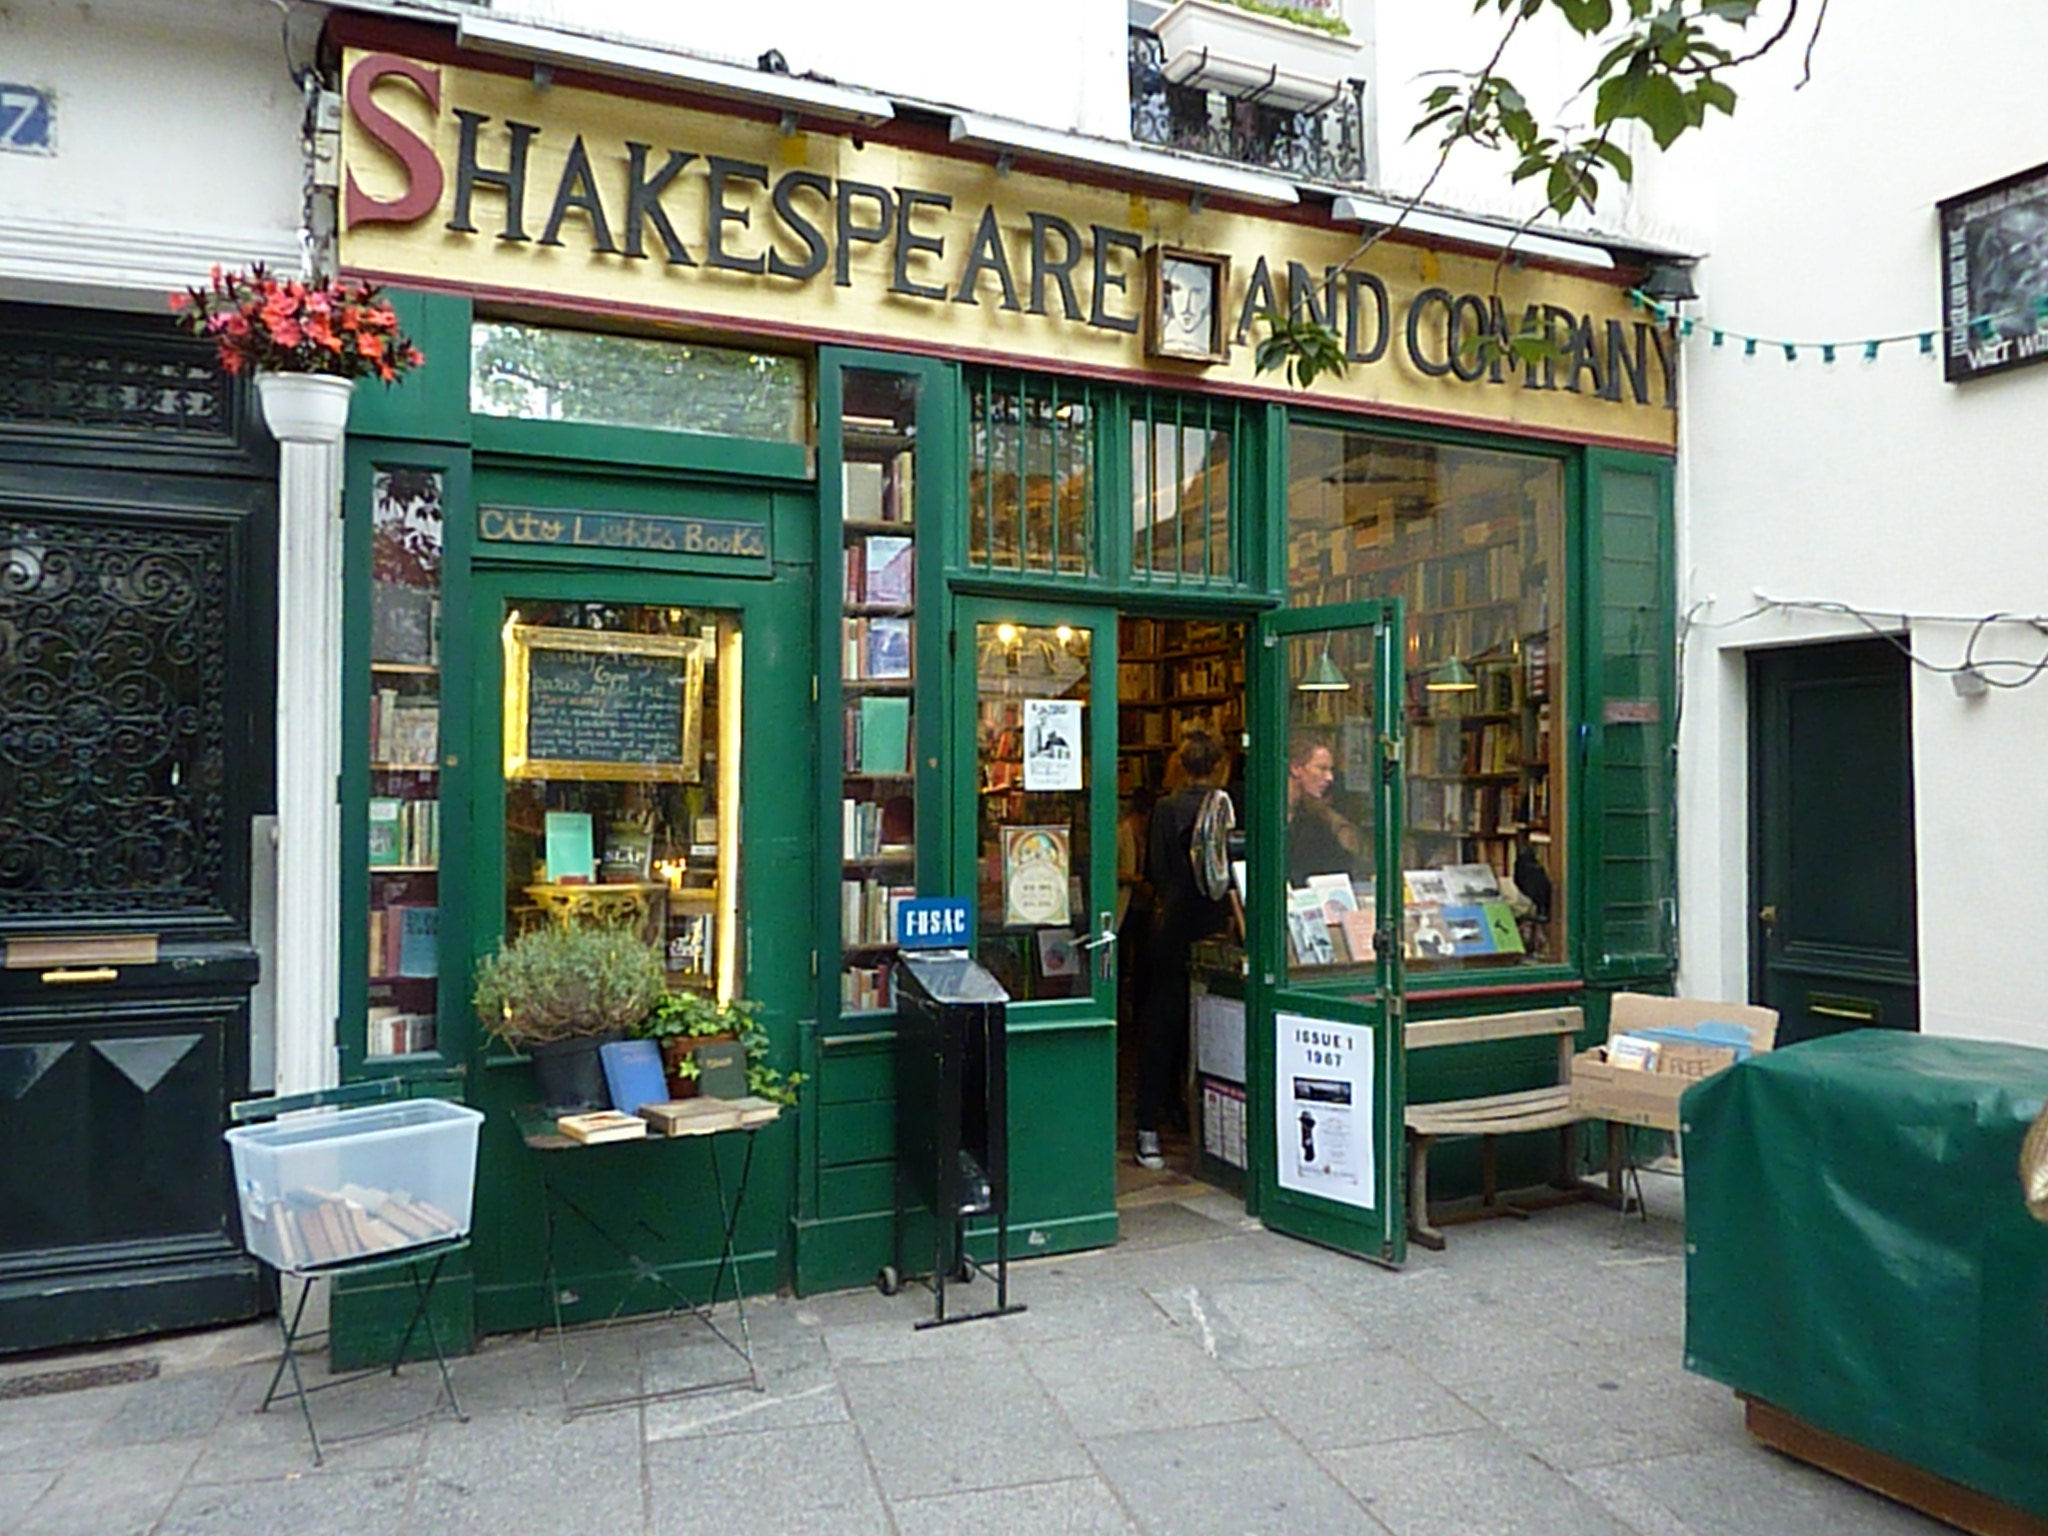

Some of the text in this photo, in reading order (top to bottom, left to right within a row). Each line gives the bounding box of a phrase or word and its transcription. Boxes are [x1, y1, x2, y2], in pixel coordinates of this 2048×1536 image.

[1, 92, 39, 144] 7
[346, 52, 1677, 410] SHAKESPEARE AND COMPANY
[905, 907, 967, 938] FUSAC
[1295, 1029, 1341, 1048] ISSUE
